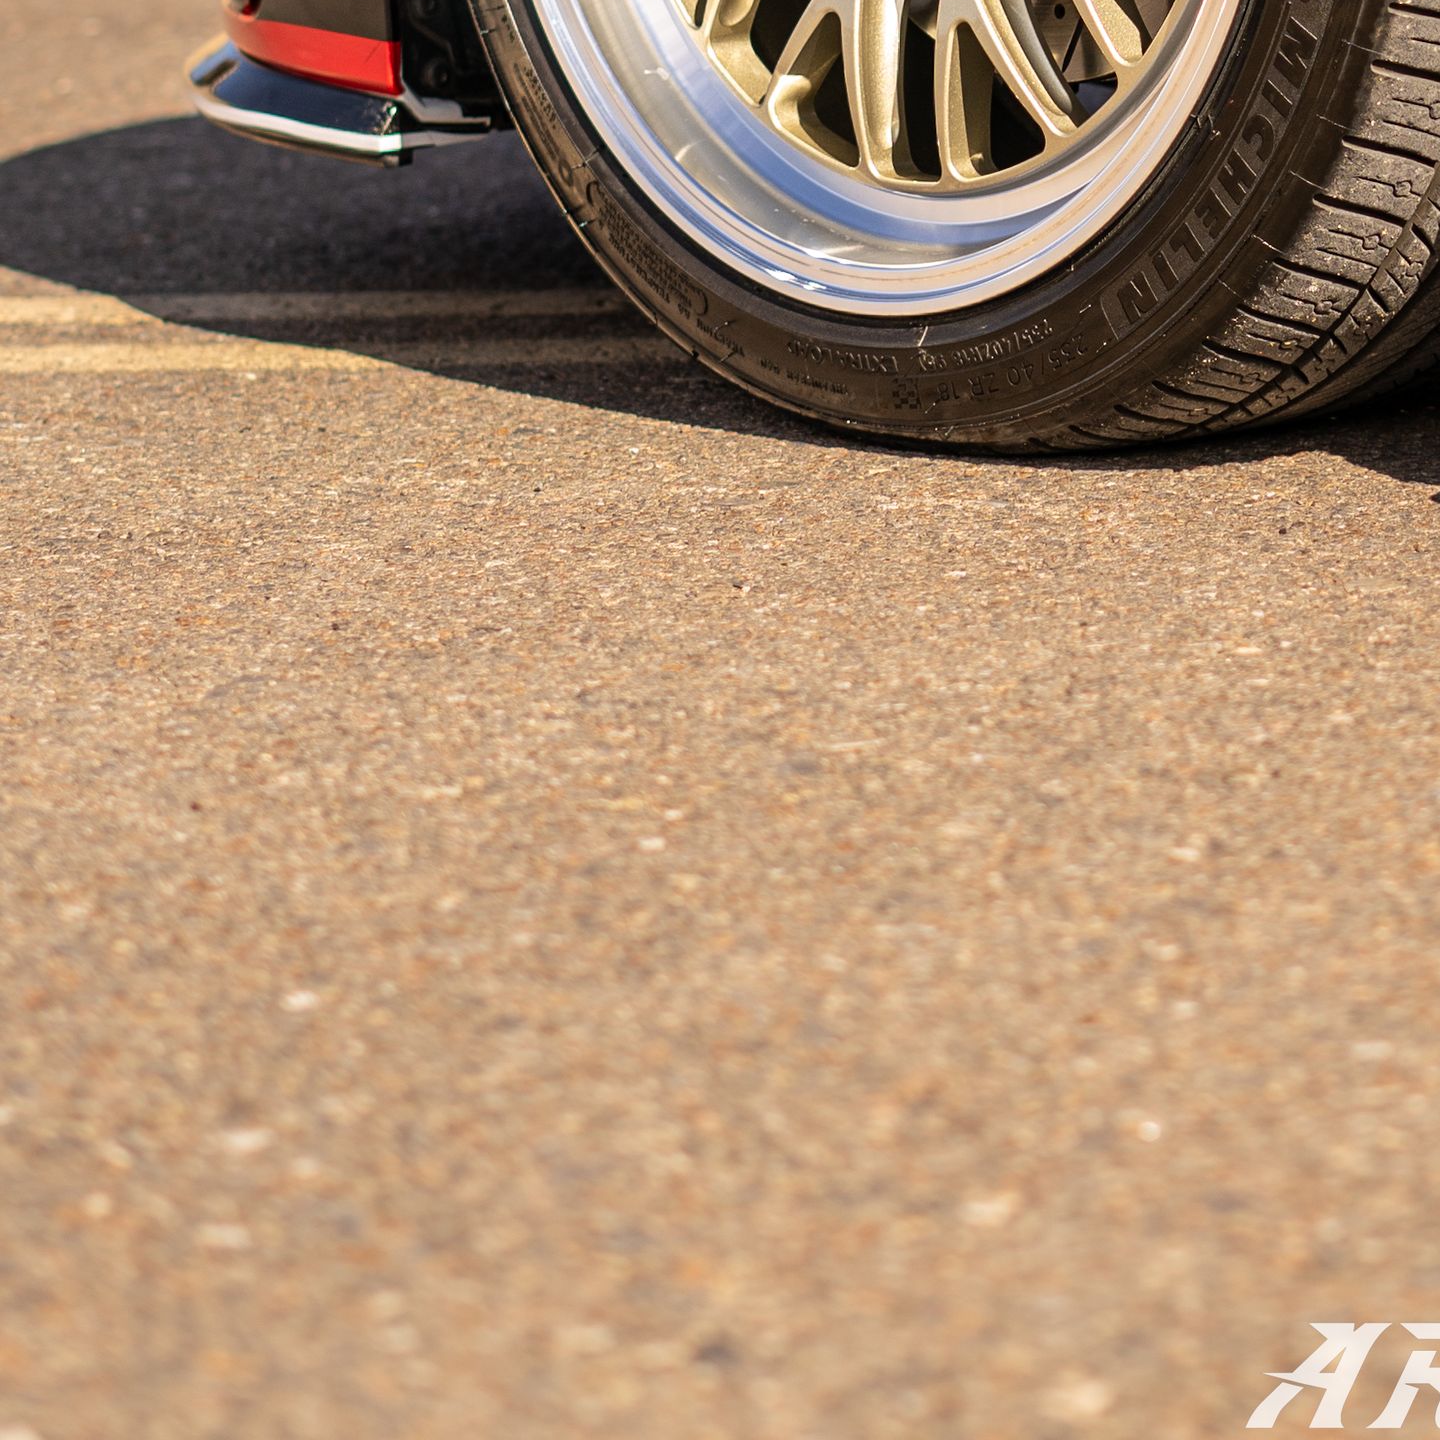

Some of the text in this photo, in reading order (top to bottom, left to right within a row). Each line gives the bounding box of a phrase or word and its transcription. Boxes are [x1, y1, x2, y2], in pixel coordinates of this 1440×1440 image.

[1118, 15, 1319, 323] MICHELIN
[936, 382, 960, 402] 18
[970, 373, 999, 399] ZR
